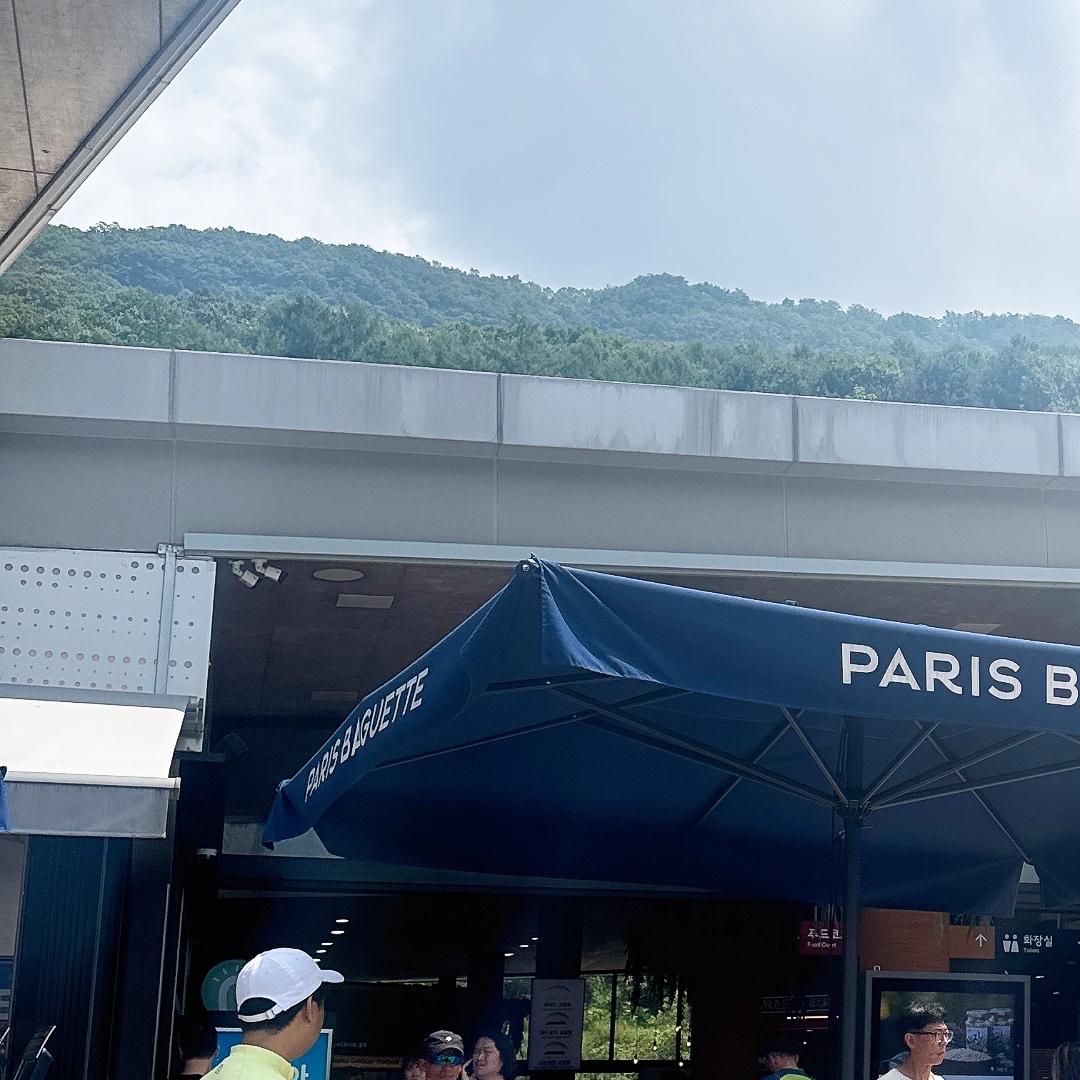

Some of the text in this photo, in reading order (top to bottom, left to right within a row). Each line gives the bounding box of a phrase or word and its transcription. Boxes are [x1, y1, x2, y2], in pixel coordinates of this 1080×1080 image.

[841, 642, 1023, 700] PARIS
[304, 667, 429, 803] PARIS BAGUETTE
[807, 928, 843, 940] 푸드코
[1023, 934, 1053, 947] 화장실
